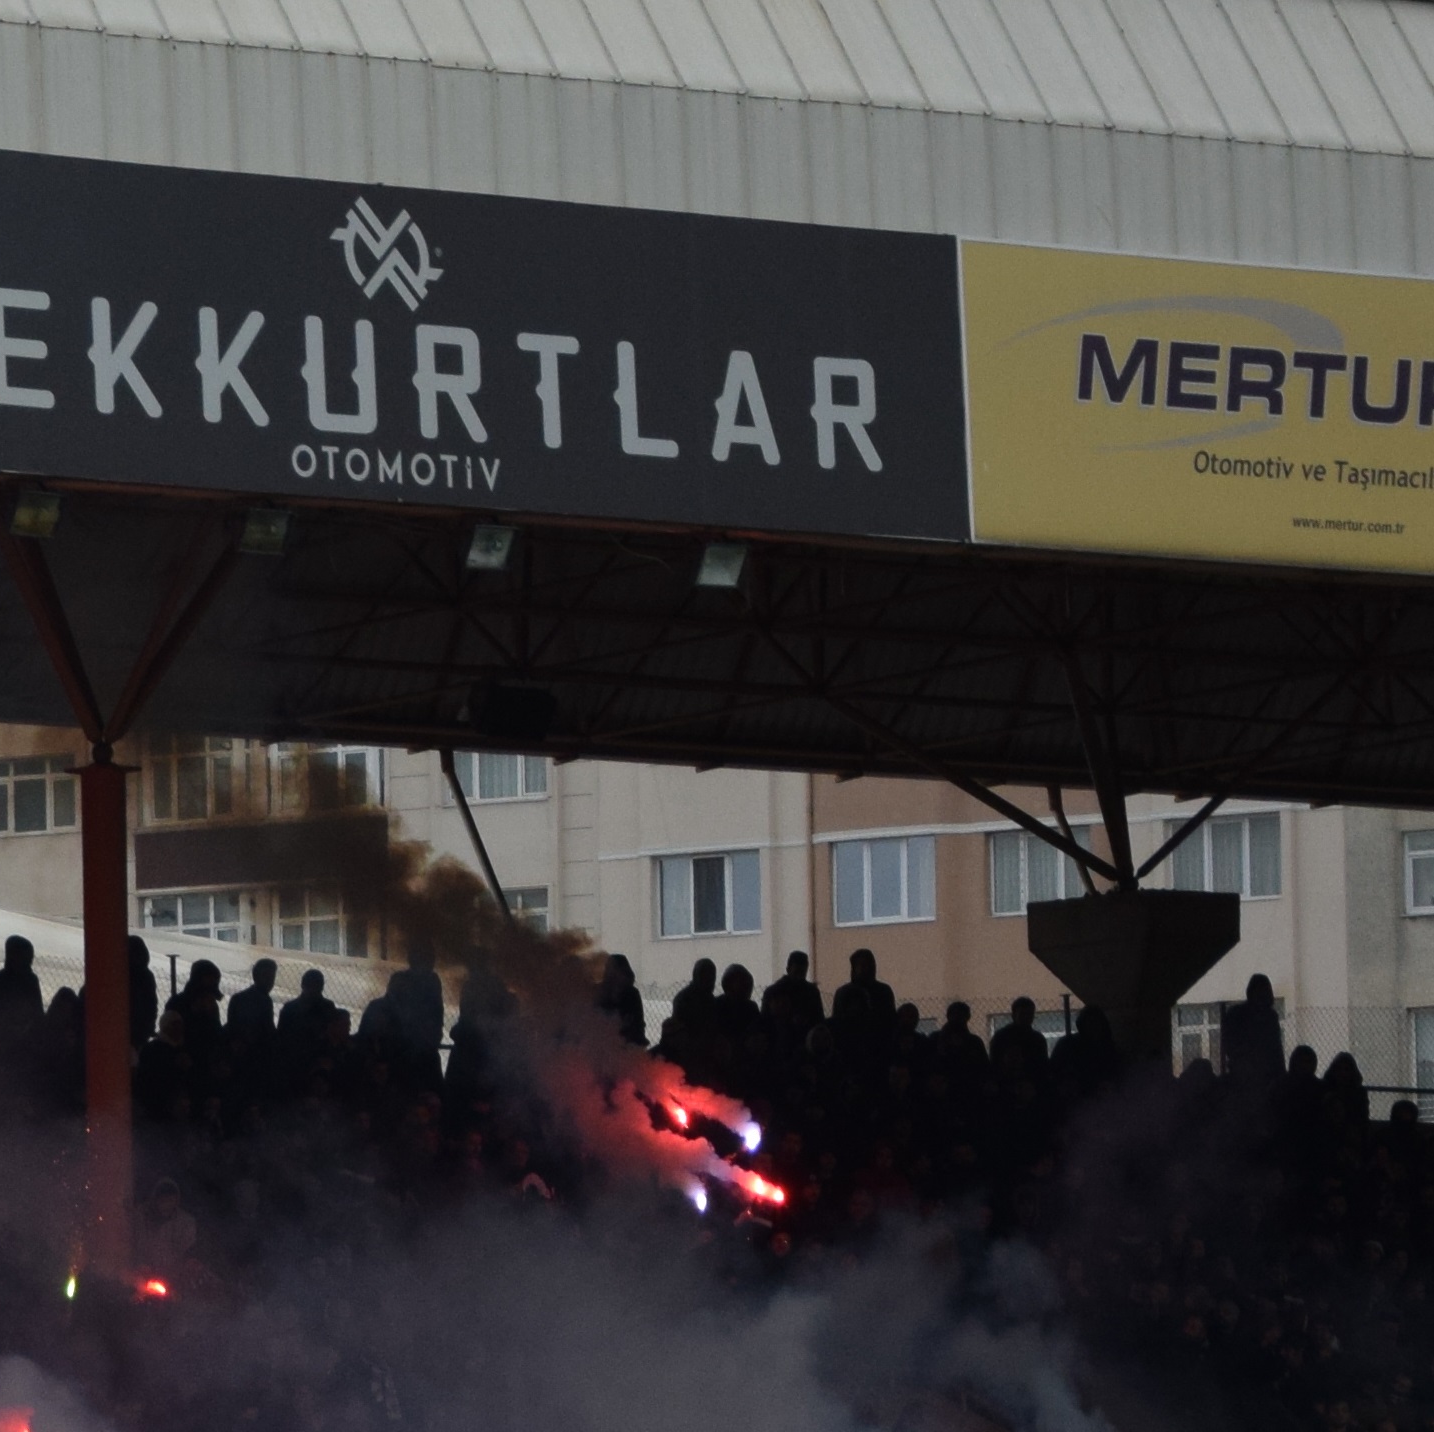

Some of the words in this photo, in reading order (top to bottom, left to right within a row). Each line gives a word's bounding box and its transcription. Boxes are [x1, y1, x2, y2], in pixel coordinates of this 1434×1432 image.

[1078, 333, 1434, 427] MERTU
[291, 444, 501, 492] OTOMOTİV
[1193, 450, 1294, 480] Otomotiv
[1301, 460, 1327, 482] ve
[1292, 516, 1406, 535] www.mertur.com.tr
